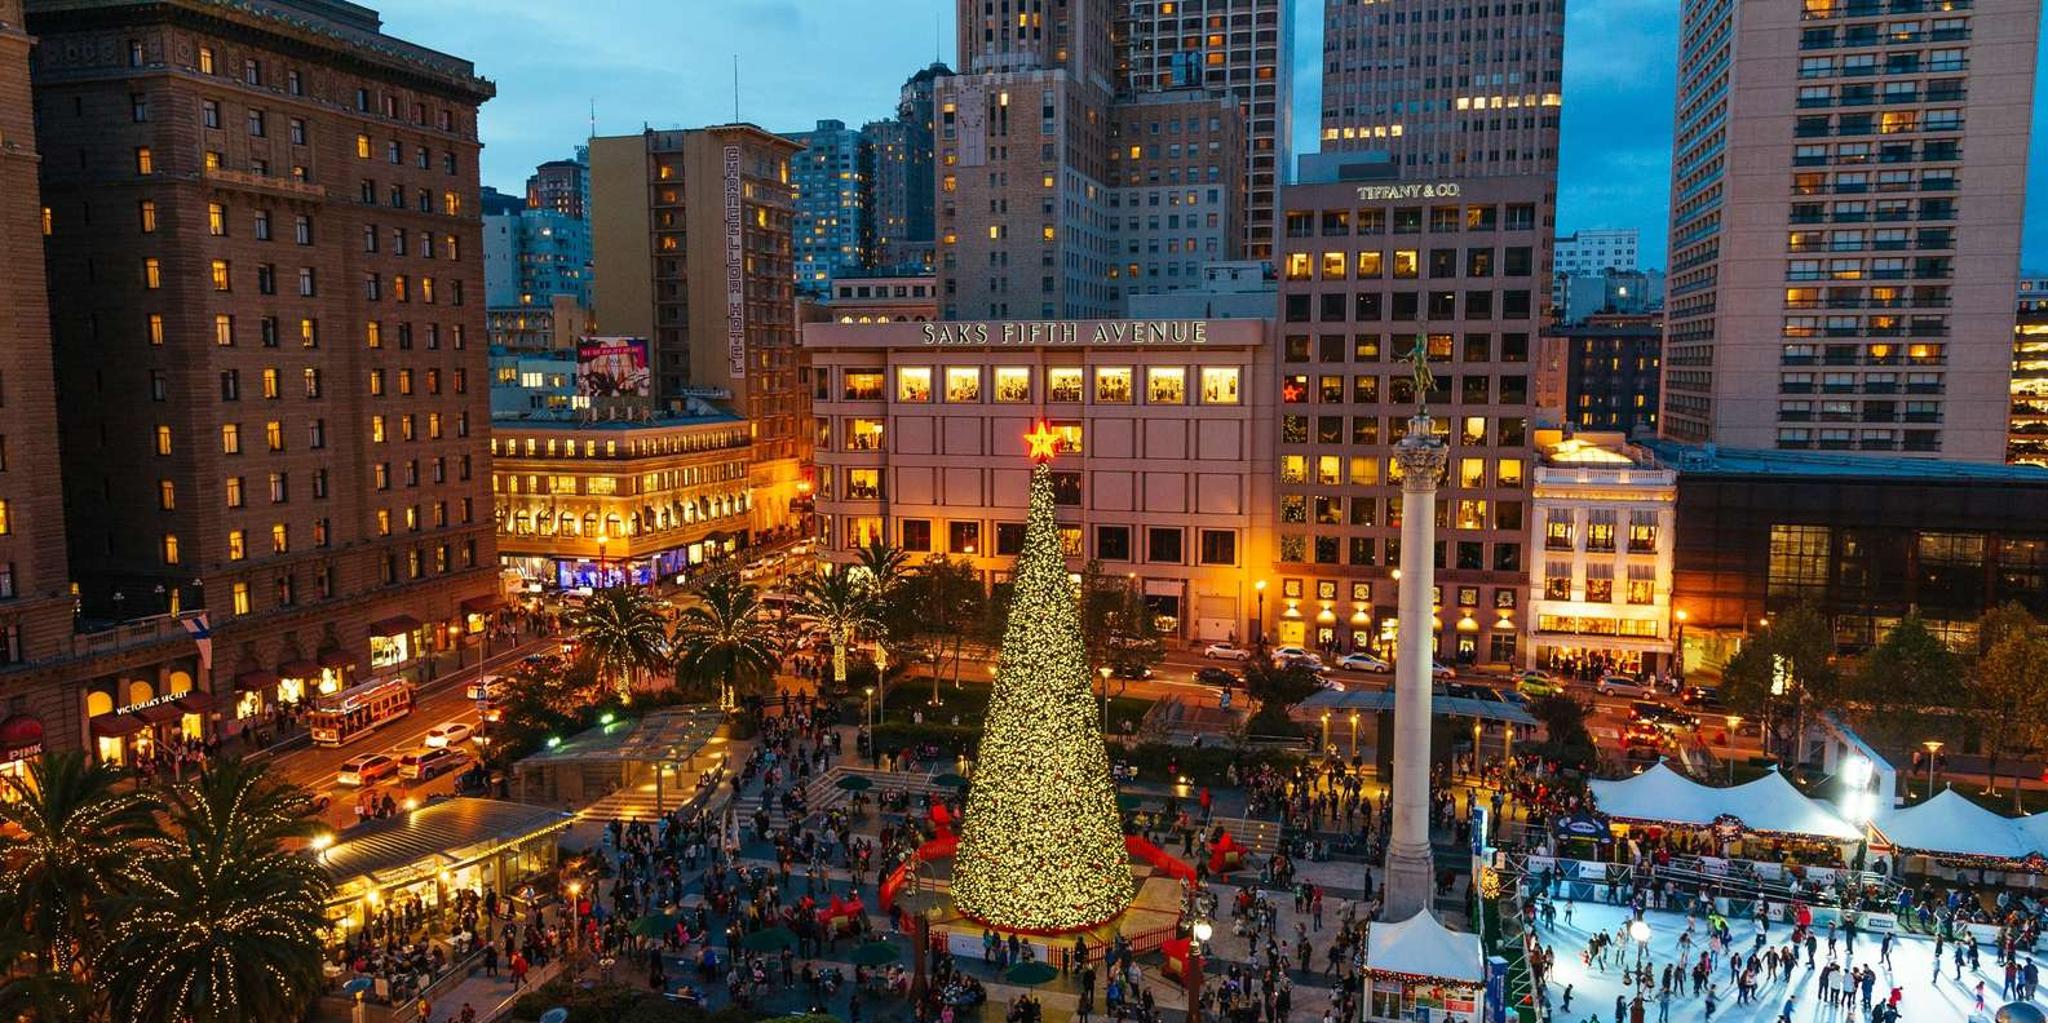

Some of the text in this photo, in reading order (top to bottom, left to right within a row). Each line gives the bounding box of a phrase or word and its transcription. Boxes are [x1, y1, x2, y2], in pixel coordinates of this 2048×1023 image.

[1357, 184, 1422, 200] TIFFANY
[1423, 183, 1435, 198] &
[726, 148, 743, 373] CHANCELLOR HOTEL
[922, 321, 1207, 345] SAKS FIFTH AVENUE
[116, 697, 160, 715] VICTORIA'S
[9, 743, 42, 760] PINK
